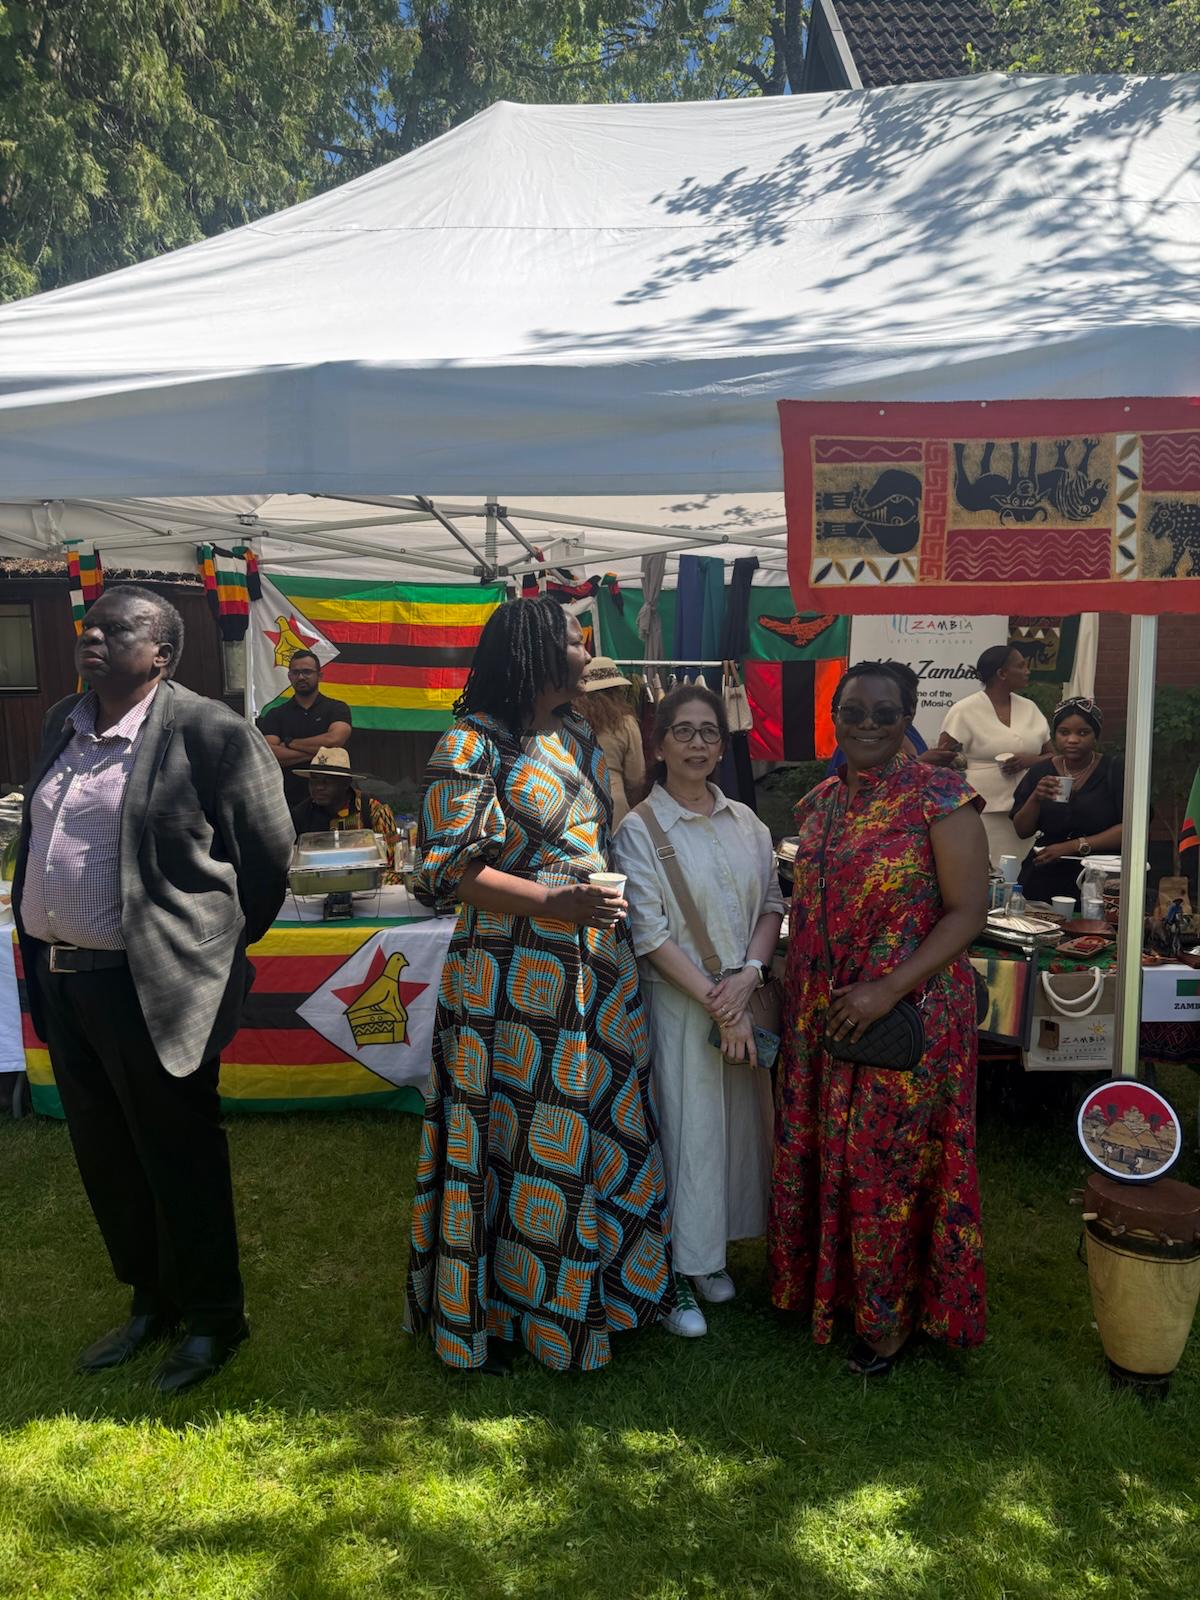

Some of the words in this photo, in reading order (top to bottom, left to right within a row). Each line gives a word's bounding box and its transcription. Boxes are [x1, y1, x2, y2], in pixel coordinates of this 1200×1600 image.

[911, 619, 974, 631] ZAMBIA
[929, 690, 938, 698] of
[939, 690, 953, 698] the
[921, 699, 957, 708] (Mosi-O
